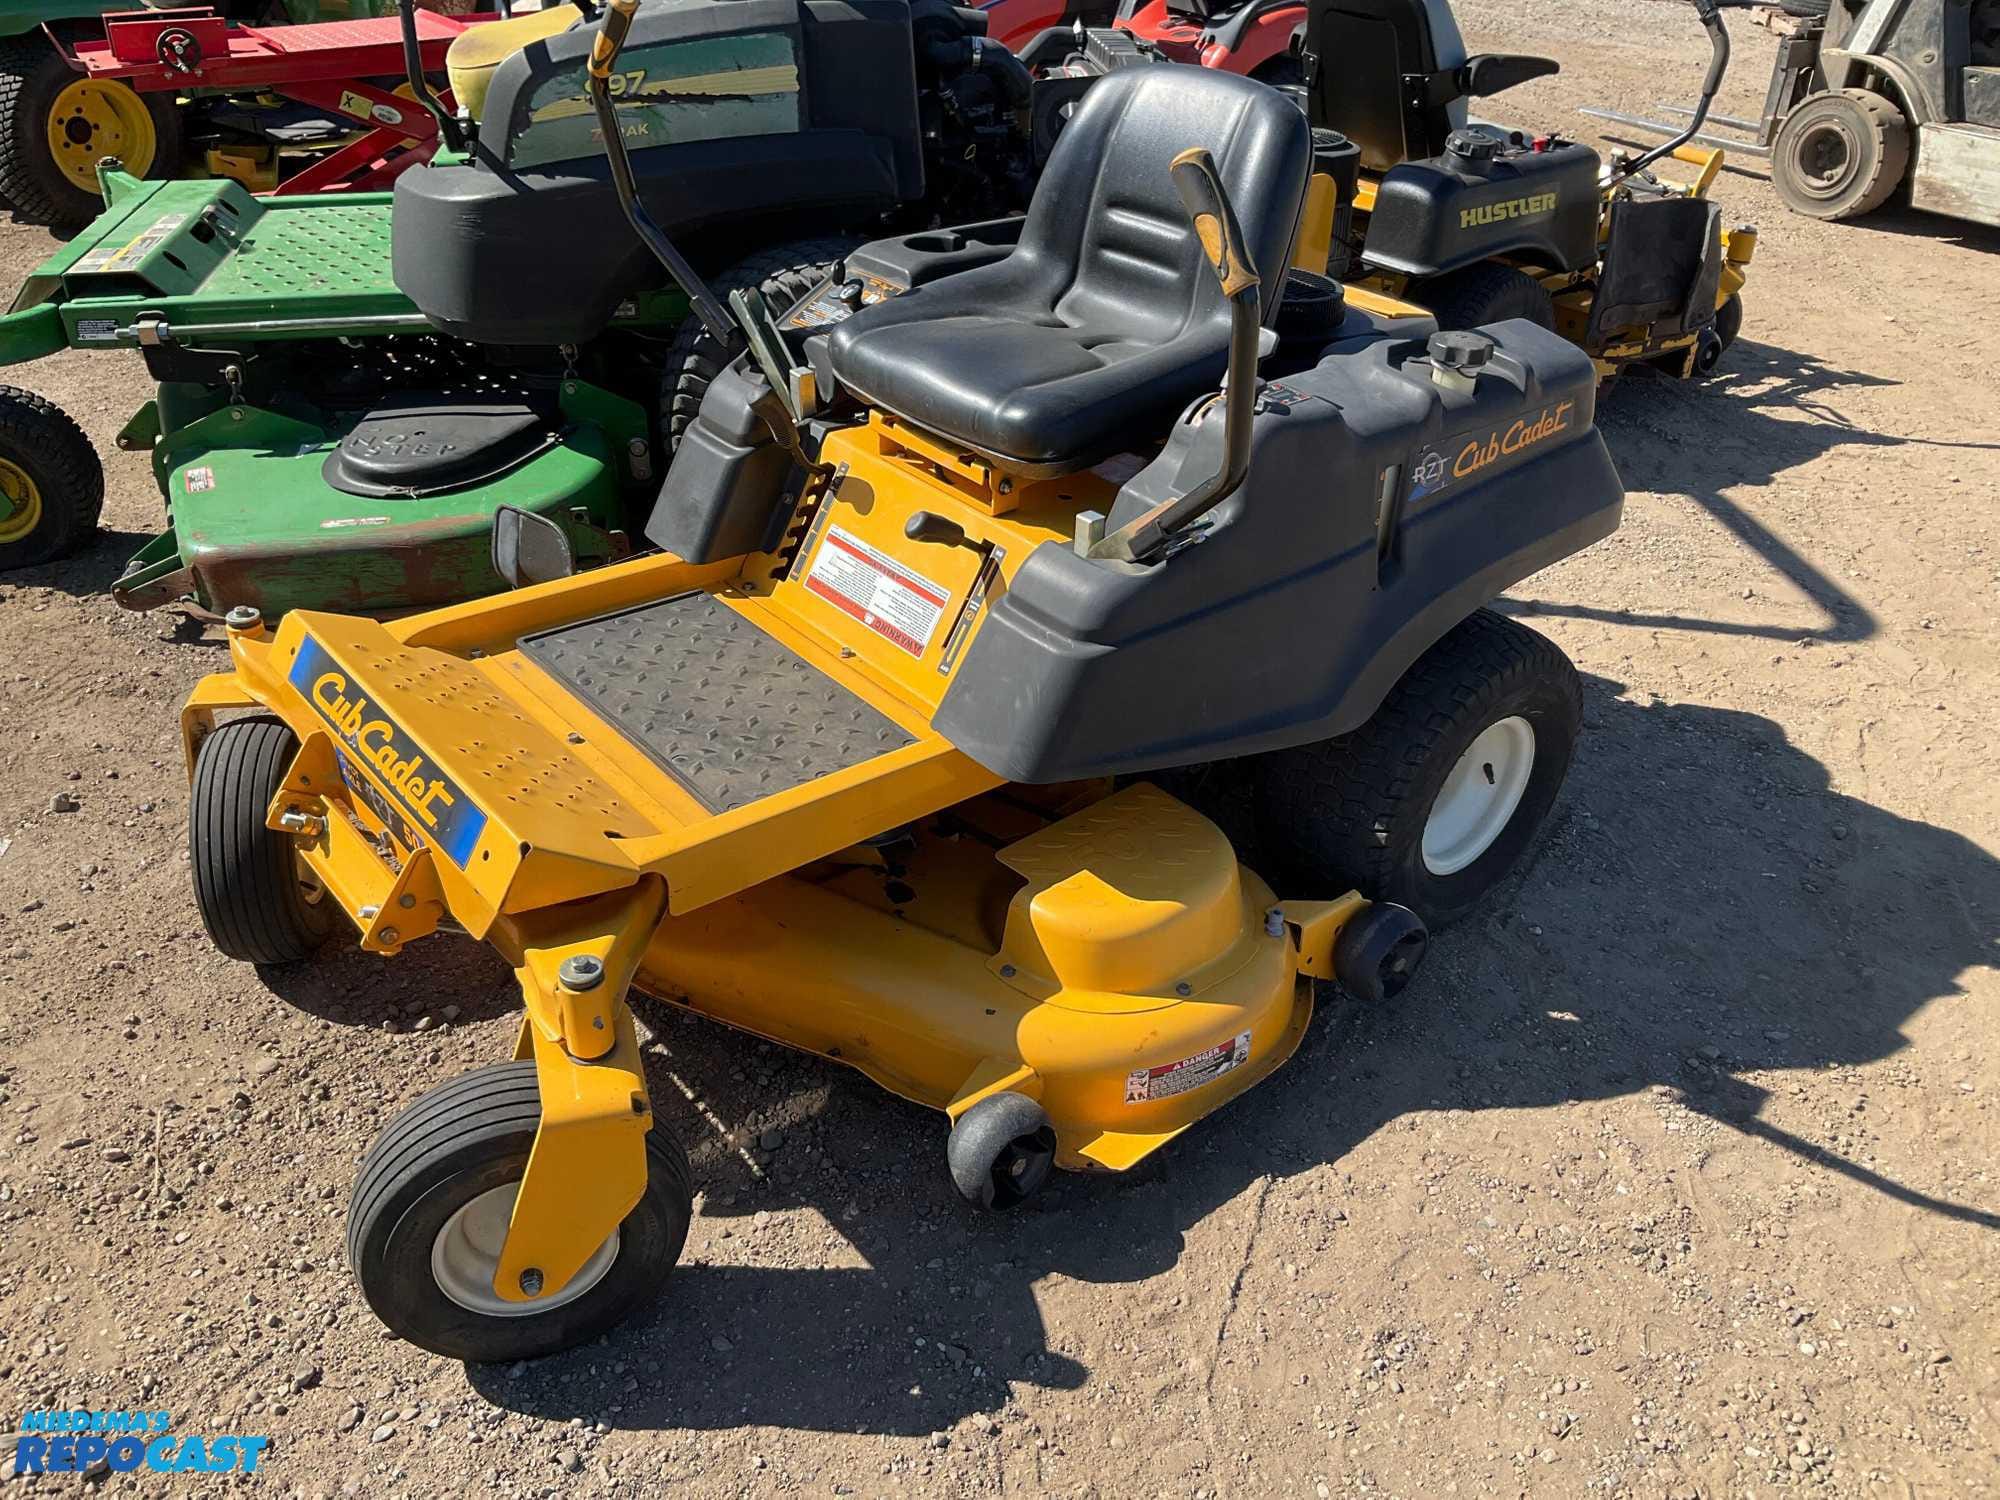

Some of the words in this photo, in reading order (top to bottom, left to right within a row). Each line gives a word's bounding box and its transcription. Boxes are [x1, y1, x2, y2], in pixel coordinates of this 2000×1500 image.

[584, 69, 646, 95] 97
[1460, 192, 1558, 228] HUSTLER
[363, 442, 457, 457] STEP
[1453, 431, 1499, 478] Cub
[1501, 400, 1573, 455] Cadet
[312, 672, 367, 737] Cub
[358, 720, 455, 827] Cadet
[1182, 1047, 1221, 1067] DANGER
